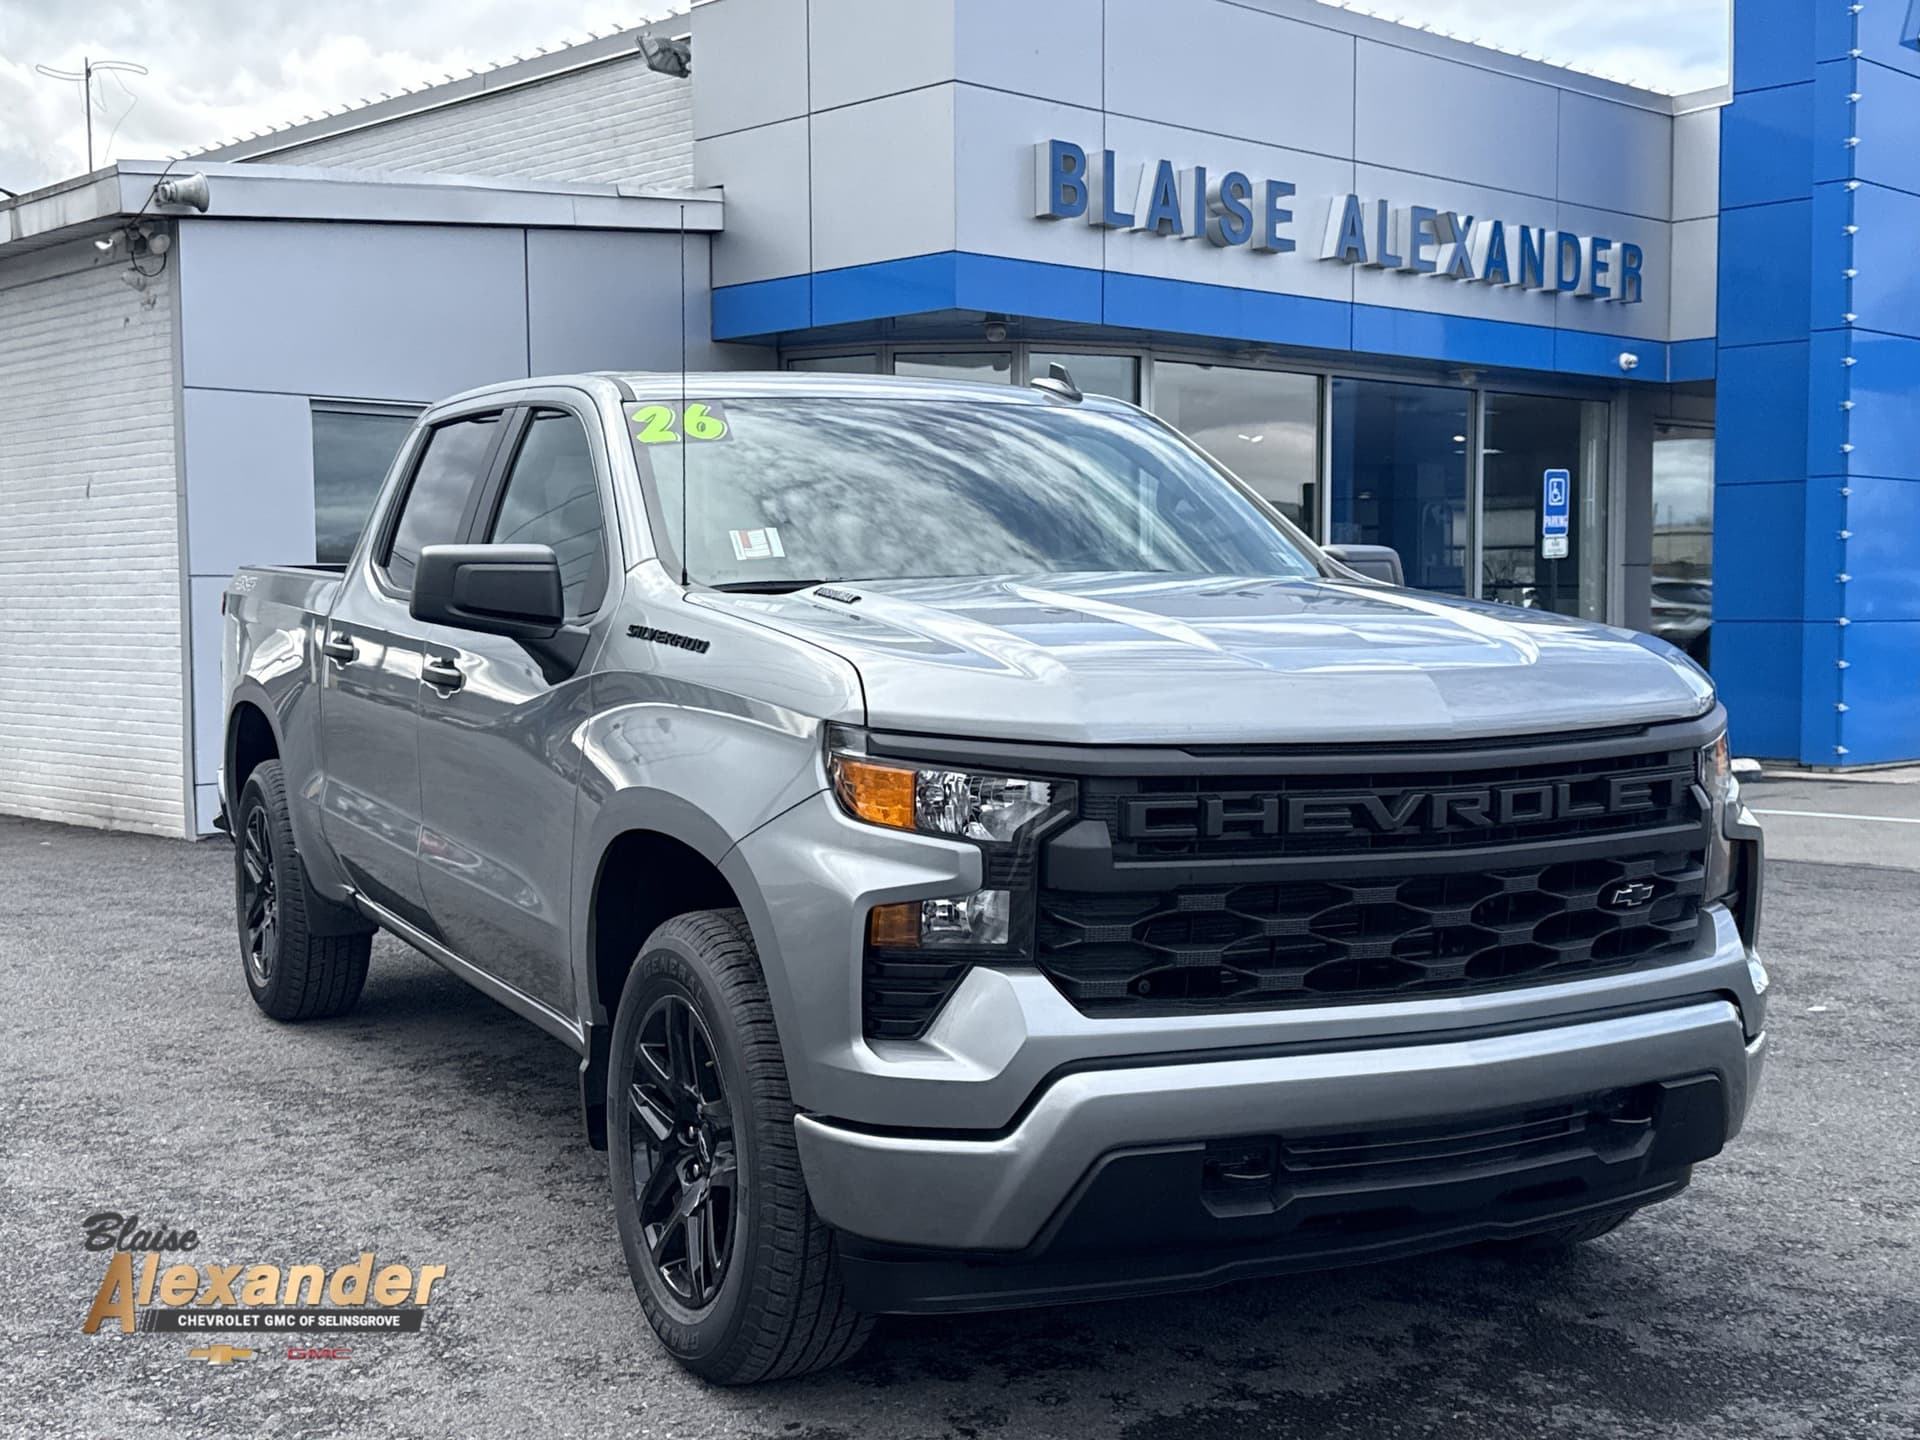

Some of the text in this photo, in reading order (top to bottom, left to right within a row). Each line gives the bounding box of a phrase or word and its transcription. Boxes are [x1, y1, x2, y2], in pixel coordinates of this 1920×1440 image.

[1037, 139, 1644, 304] BLAISE ALEXANDER
[631, 402, 728, 444] 26
[627, 624, 710, 654] SILVERADO
[1122, 772, 1697, 838] CHEVROLET
